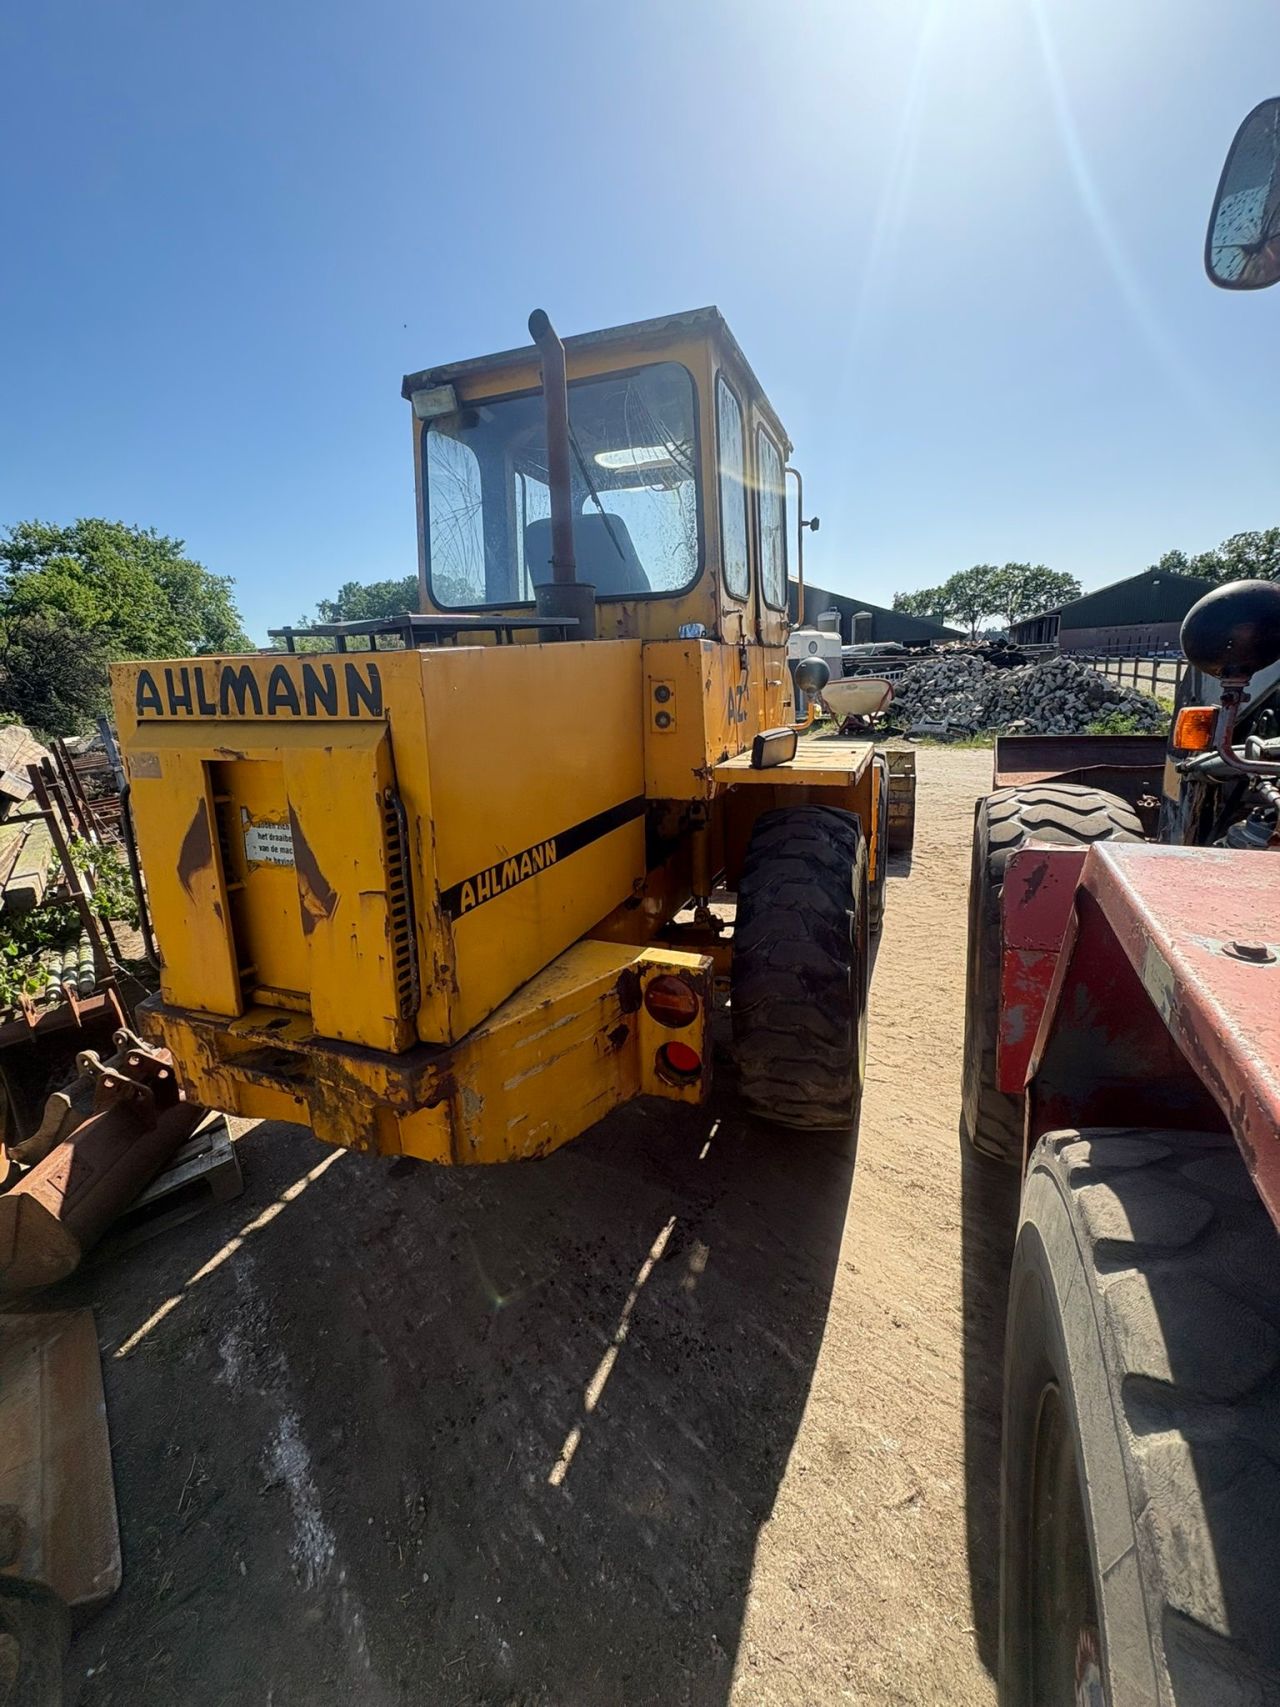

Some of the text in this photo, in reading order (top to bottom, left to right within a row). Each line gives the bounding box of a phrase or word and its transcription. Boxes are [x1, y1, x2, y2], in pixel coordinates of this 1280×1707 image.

[136, 663, 382, 716] AHLMANN
[257, 832, 268, 840] het
[270, 845, 279, 853] de
[460, 839, 557, 913] AHLMANN
